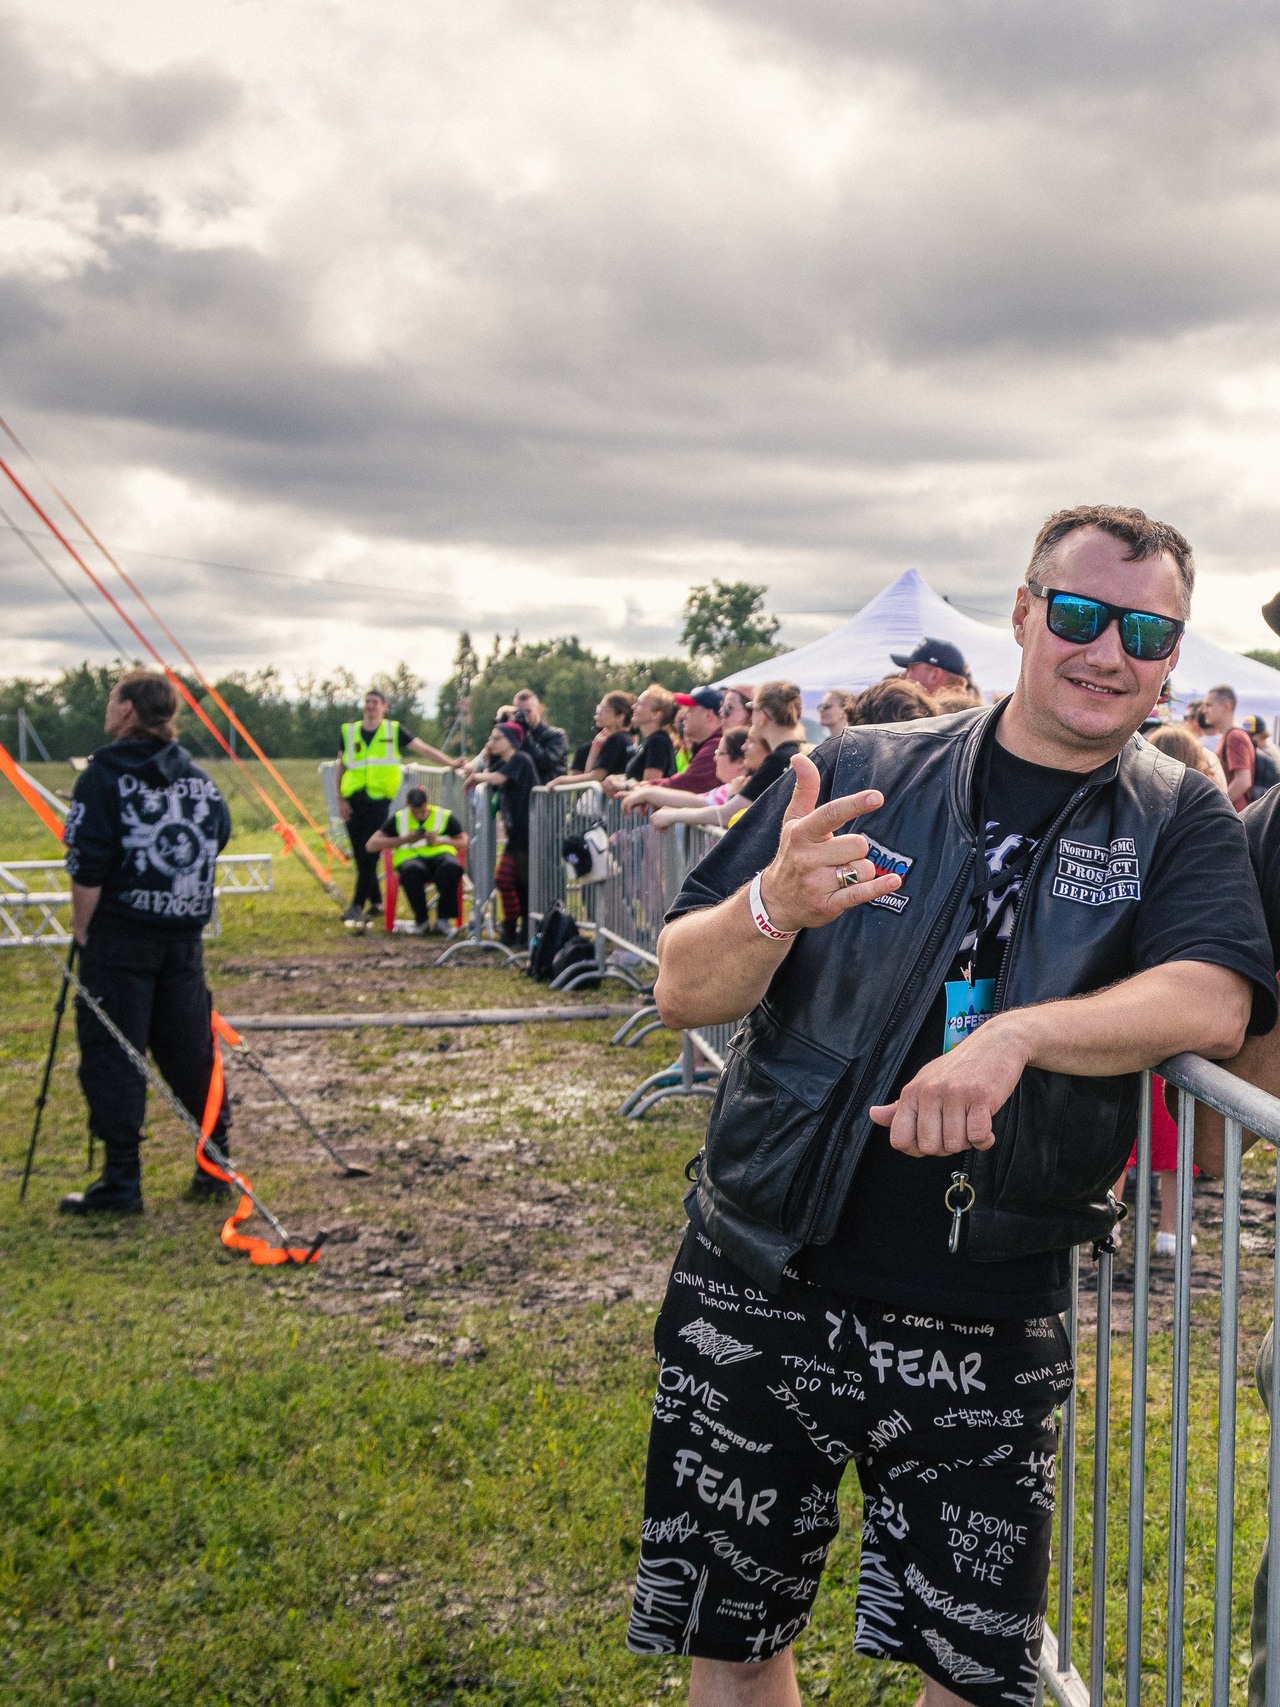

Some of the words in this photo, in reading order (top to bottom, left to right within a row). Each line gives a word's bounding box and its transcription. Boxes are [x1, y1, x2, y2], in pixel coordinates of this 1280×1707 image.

[867, 843, 910, 875] RMC
[1058, 882, 1136, 903] ВЕРТОЛЁТ
[949, 1016, 964, 1030] 29
[673, 1271, 705, 1289] WIND
[708, 1280, 739, 1297] THE
[698, 1292, 741, 1312] THROW
[745, 1305, 806, 1322] CAUTION
[744, 1288, 769, 1302] TO
[902, 1314, 944, 1331] SUCH
[950, 1323, 995, 1337] THING
[781, 1355, 836, 1375] TRYING
[843, 1370, 863, 1382] TO
[868, 1341, 986, 1395] FEAR
[1014, 1366, 1054, 1385] WIND
[795, 1376, 822, 1392] DO
[672, 1449, 778, 1527] FEAR
[917, 1468, 938, 1484] TO
[940, 1501, 961, 1522] IN
[967, 1510, 1028, 1545] ROME
[703, 1530, 784, 1586] HONEST
[947, 1528, 979, 1552] DO
[984, 1541, 1015, 1564] AS
[952, 1552, 1005, 1586] THE
